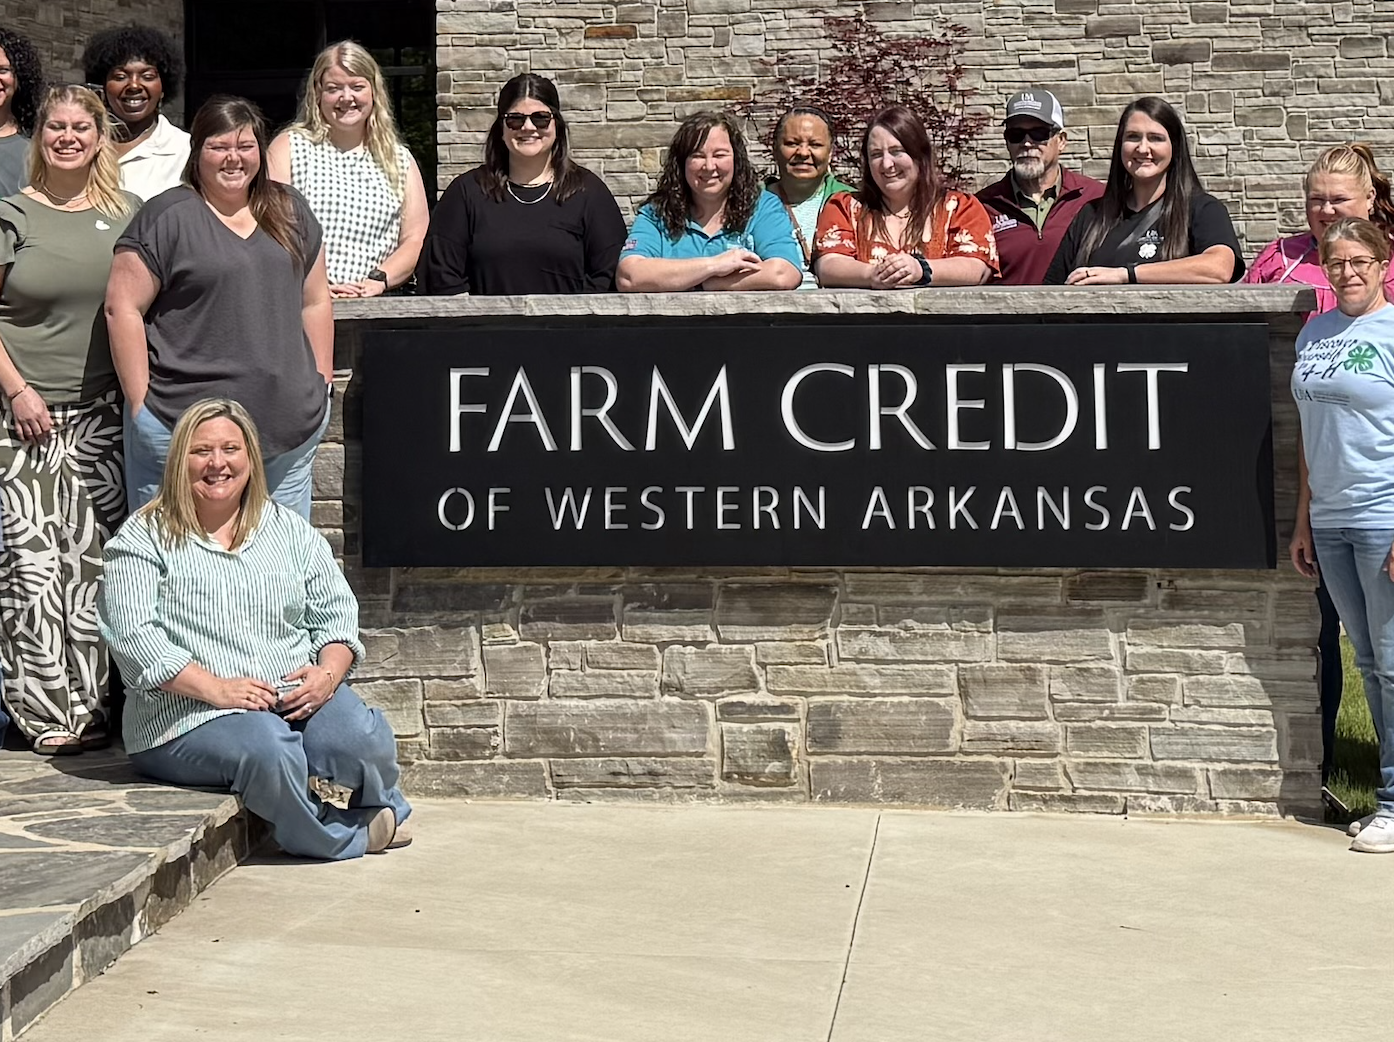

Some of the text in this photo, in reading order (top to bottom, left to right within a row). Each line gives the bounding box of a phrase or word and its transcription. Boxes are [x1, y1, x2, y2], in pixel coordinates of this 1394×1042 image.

[1301, 360, 1344, 382] 4-H
[448, 361, 1190, 453] FARM CREDIT
[436, 484, 1196, 531] OF WESTERN ARKANSAS
